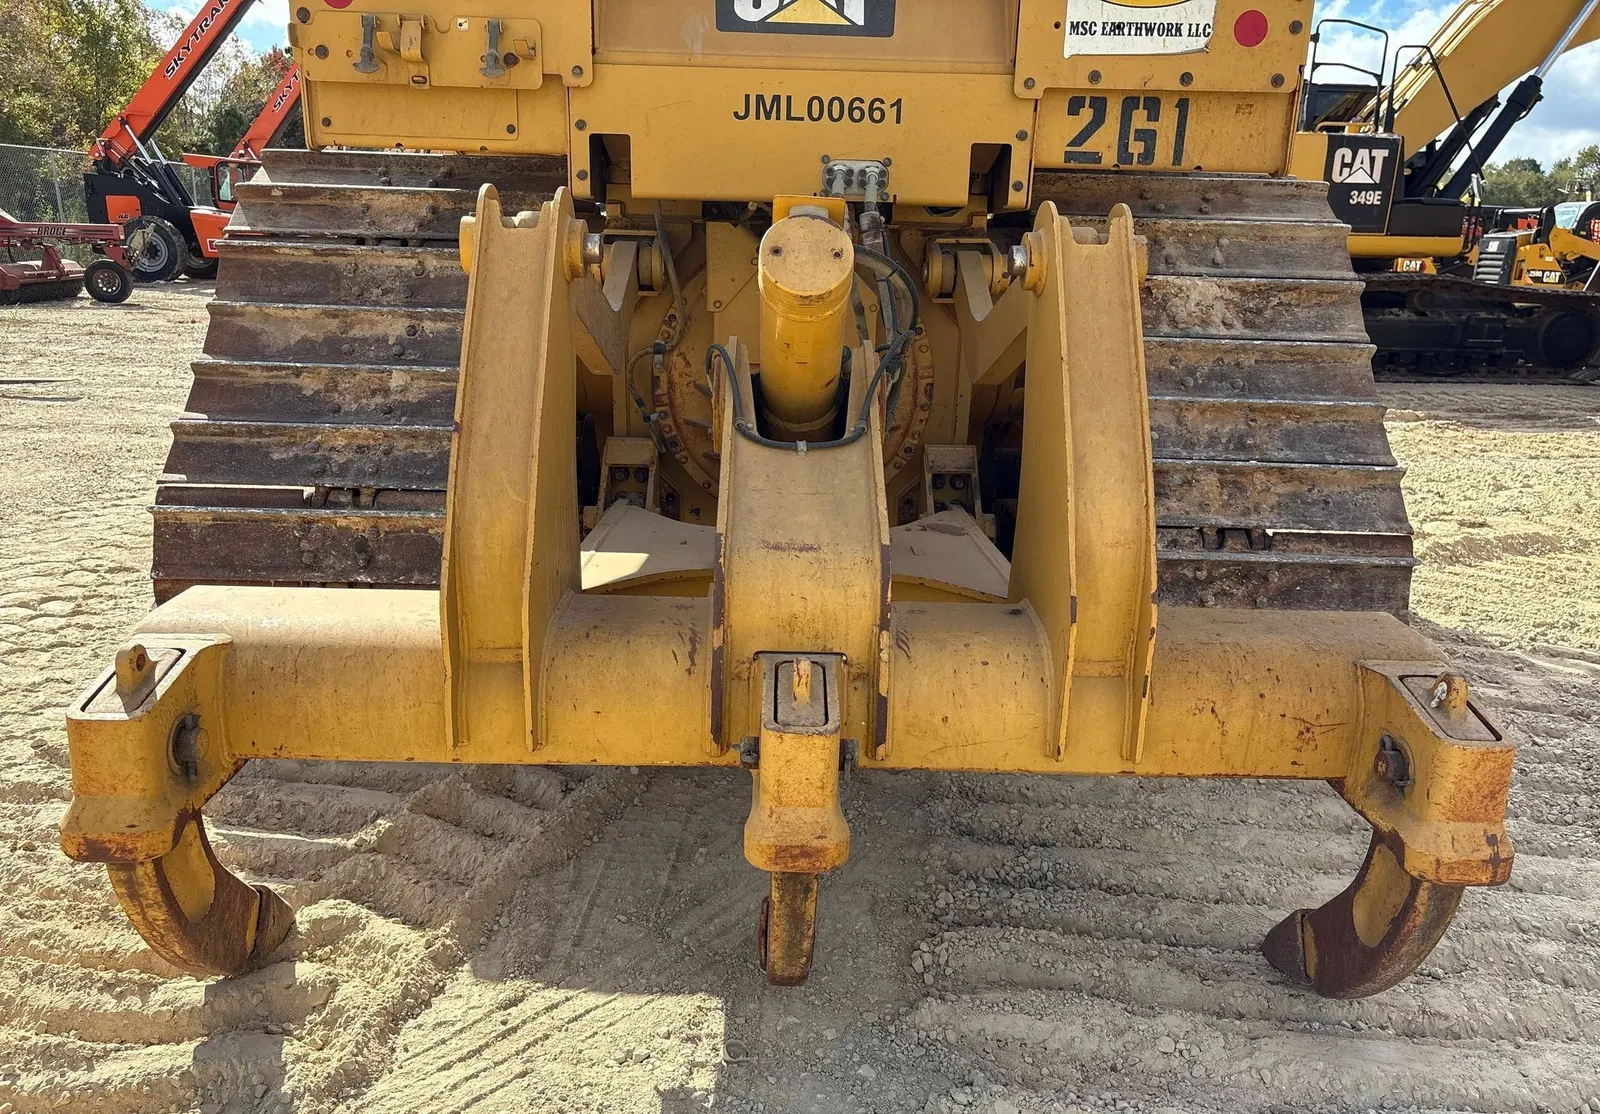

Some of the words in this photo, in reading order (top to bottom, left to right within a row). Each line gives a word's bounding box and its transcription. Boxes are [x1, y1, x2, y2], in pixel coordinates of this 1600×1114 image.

[1069, 21, 1097, 36] MSC
[1101, 22, 1183, 37] EARTHWORK
[1187, 23, 1211, 38] LLC
[733, 93, 903, 124] JML00661
[1331, 147, 1389, 184] CAT
[1349, 190, 1382, 205] 349E
[37, 226, 68, 236] BROCE
[1402, 260, 1422, 272] CAT
[1542, 270, 1561, 284] CAT
